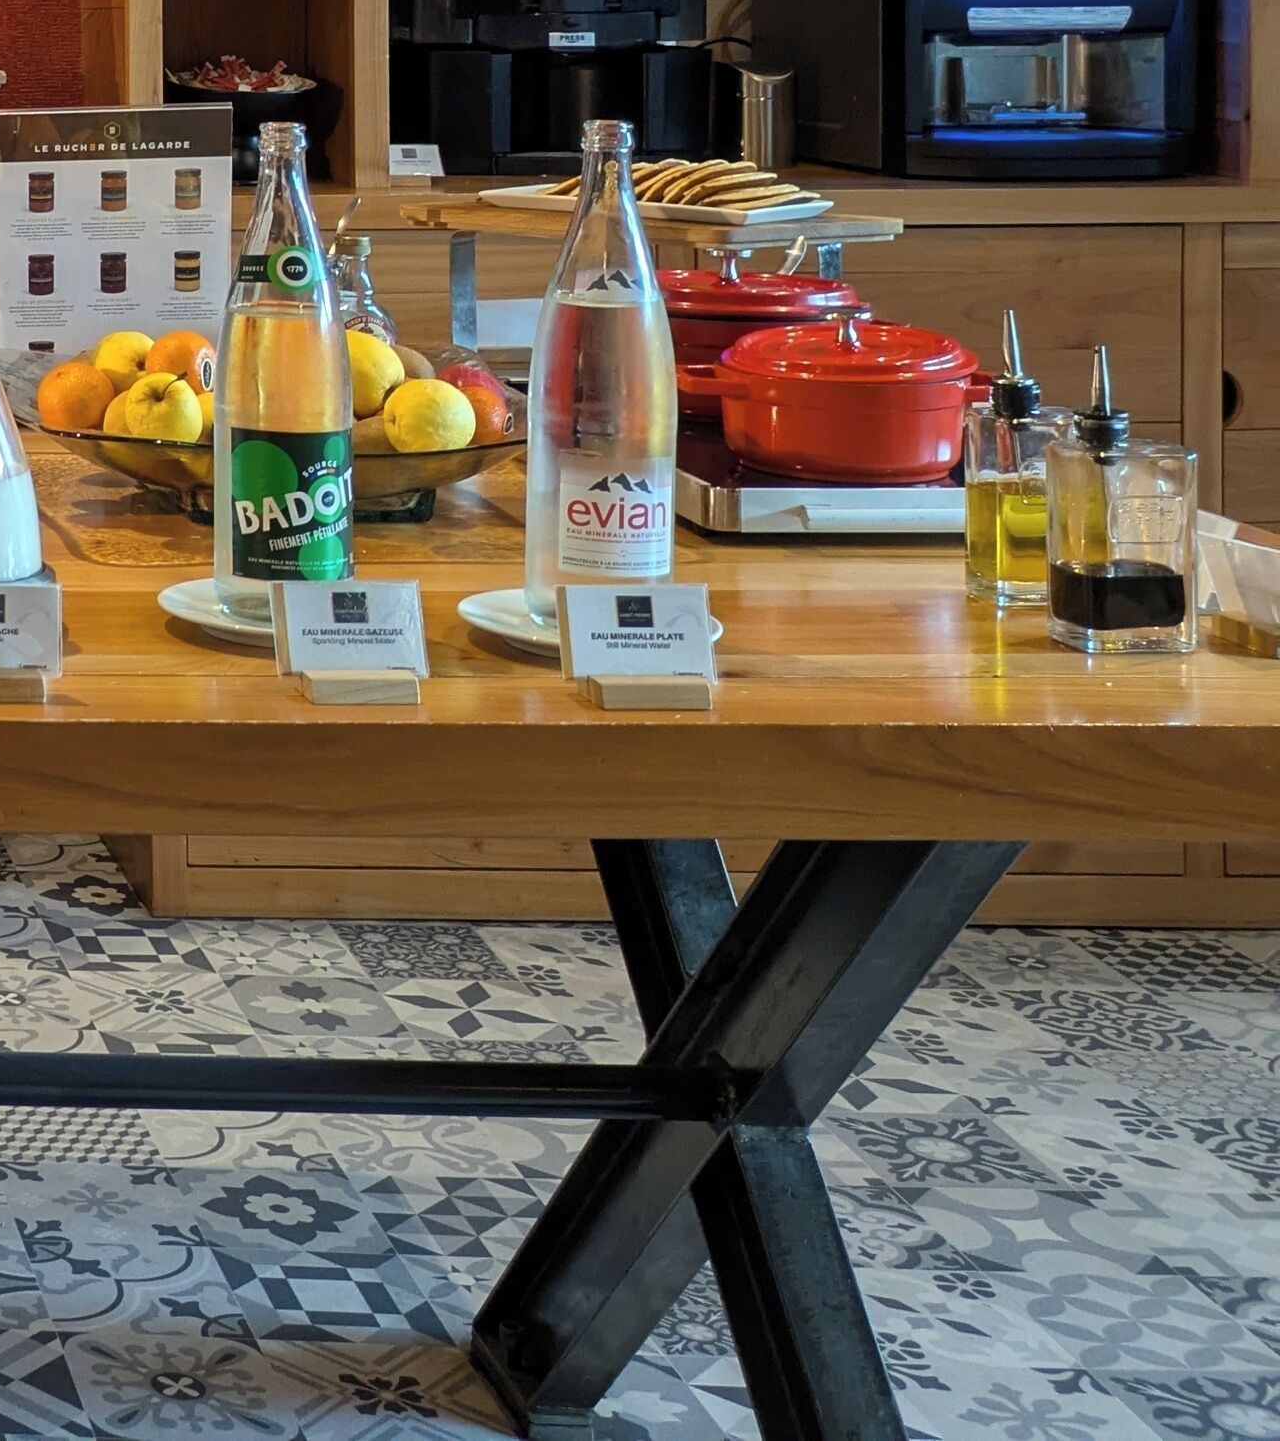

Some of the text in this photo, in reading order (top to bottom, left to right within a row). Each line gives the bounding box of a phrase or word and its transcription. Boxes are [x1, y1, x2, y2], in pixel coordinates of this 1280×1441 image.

[34, 140, 191, 153] LE RUCHER DE LAGARDE
[302, 460, 338, 478] SOURCE
[235, 466, 353, 535] BADOIT
[567, 497, 666, 530] evian
[567, 527, 582, 535] EAU
[268, 533, 312, 552] FINEMENT
[347, 637, 374, 645] Mineral
